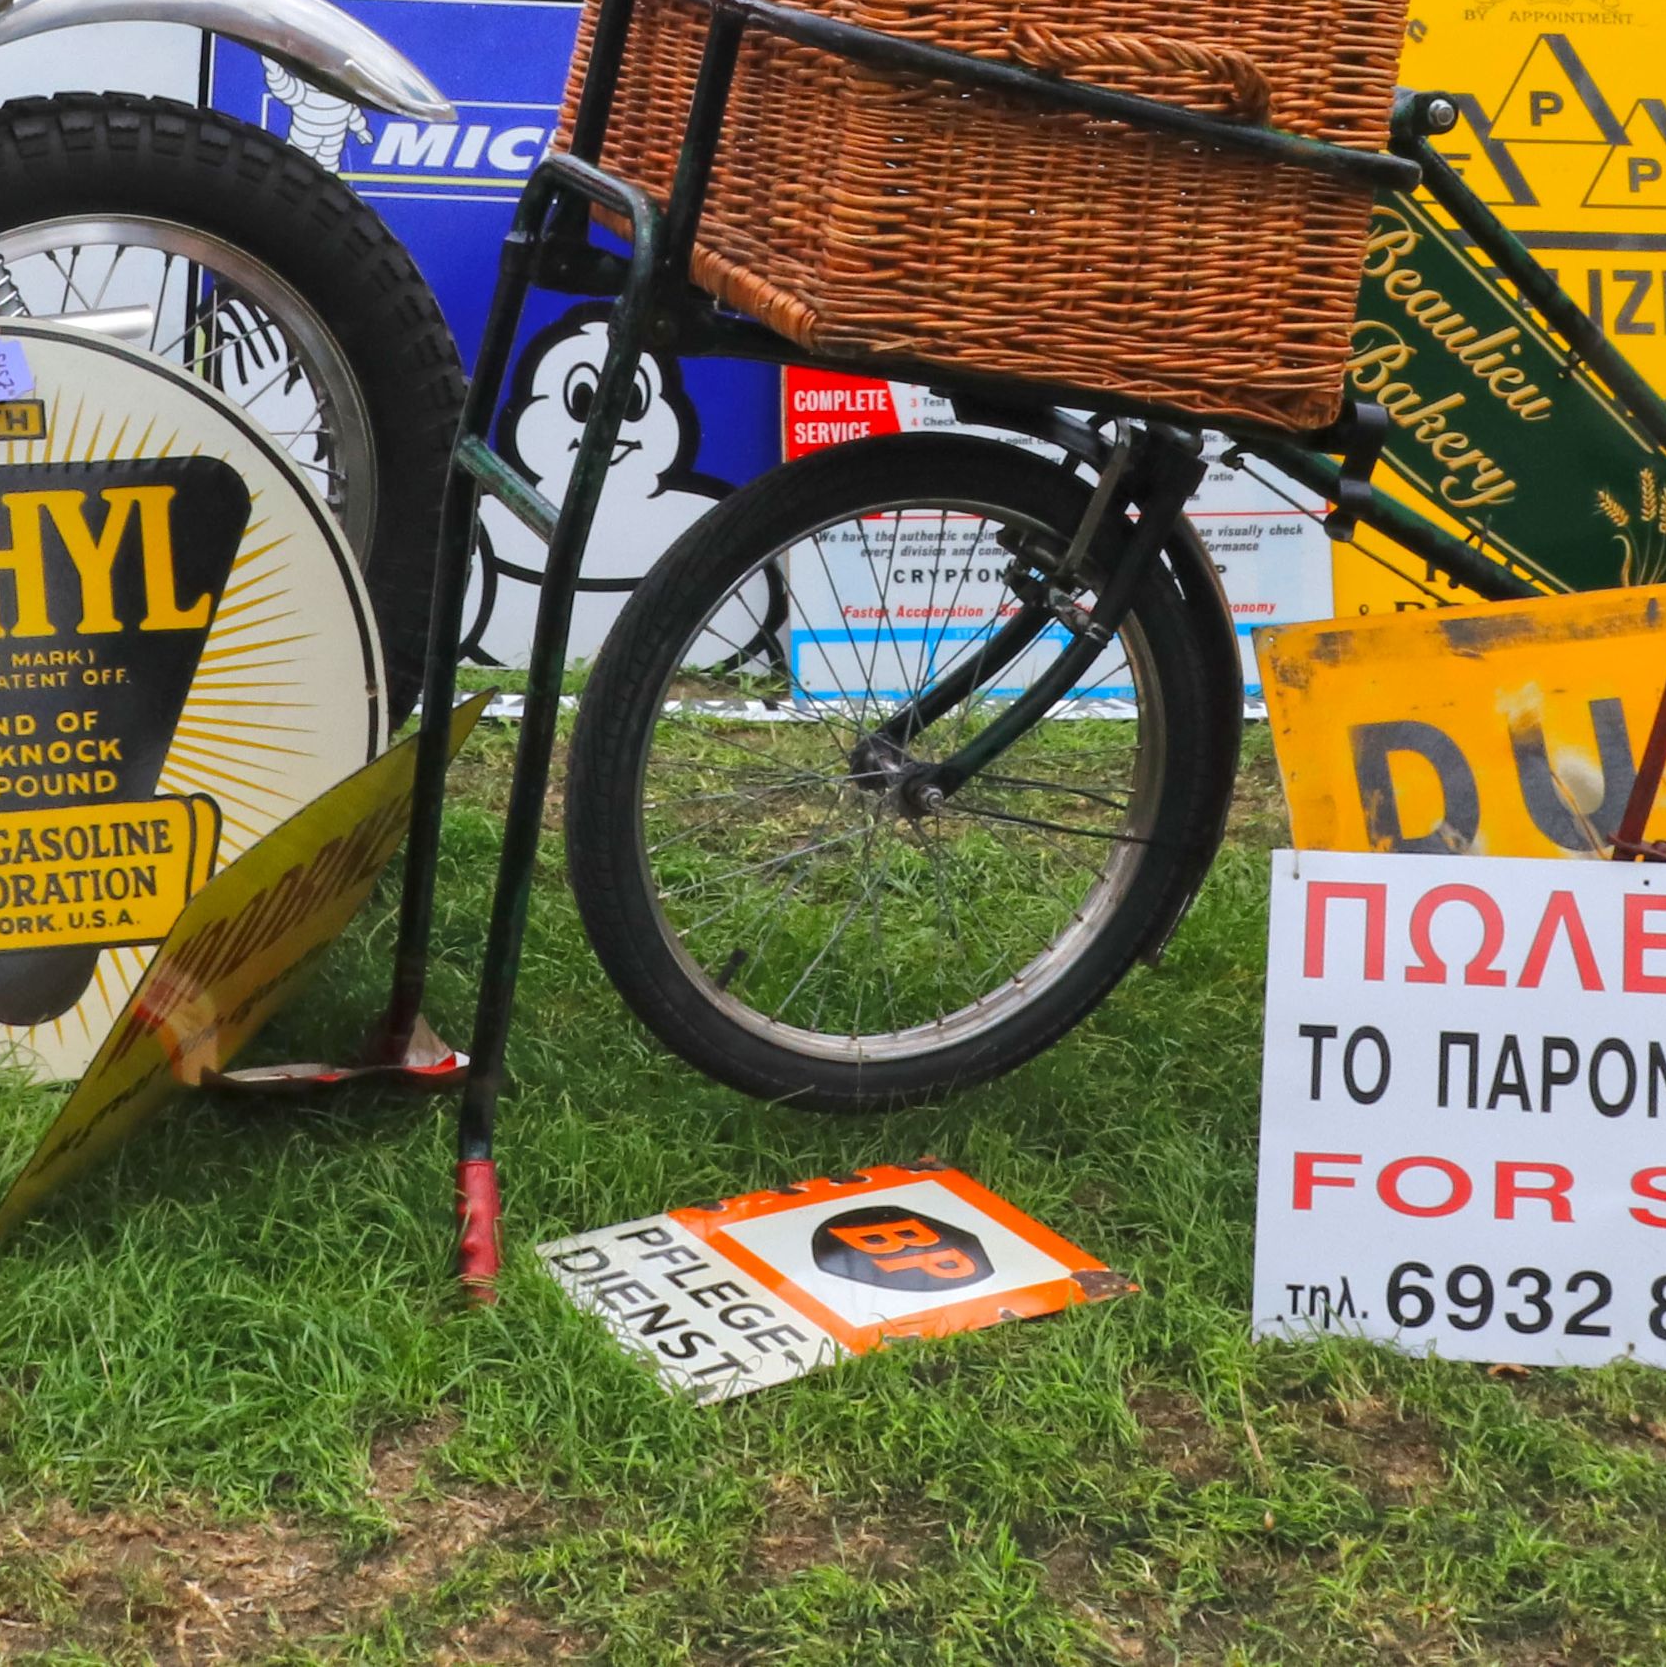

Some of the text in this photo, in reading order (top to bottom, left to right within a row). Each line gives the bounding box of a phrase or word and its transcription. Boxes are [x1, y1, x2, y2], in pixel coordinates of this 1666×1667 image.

[1464, 8, 1633, 26] BY APPOINTMENT
[1529, 91, 1564, 127] P
[1627, 157, 1662, 193] P
[1366, 204, 1552, 423] Beaulieu
[793, 389, 888, 413] COMPLETE
[1341, 317, 1516, 510] Bakery
[1208, 472, 1234, 483] ratio
[899, 524, 1303, 542] authentic visually check
[900, 545, 972, 558] division and
[896, 604, 983, 618] Acceleration
[11, 648, 96, 667] MARK)
[82, 668, 132, 686] OFF.
[55, 710, 99, 733] OF
[67, 909, 141, 931] U.S.A.
[1297, 1023, 1393, 1106] ΤΟ
[1291, 1151, 1575, 1227] FOR
[828, 1218, 978, 1280] BP
[1385, 1260, 1612, 1337] 6932
[551, 1245, 754, 1380] DIENST
